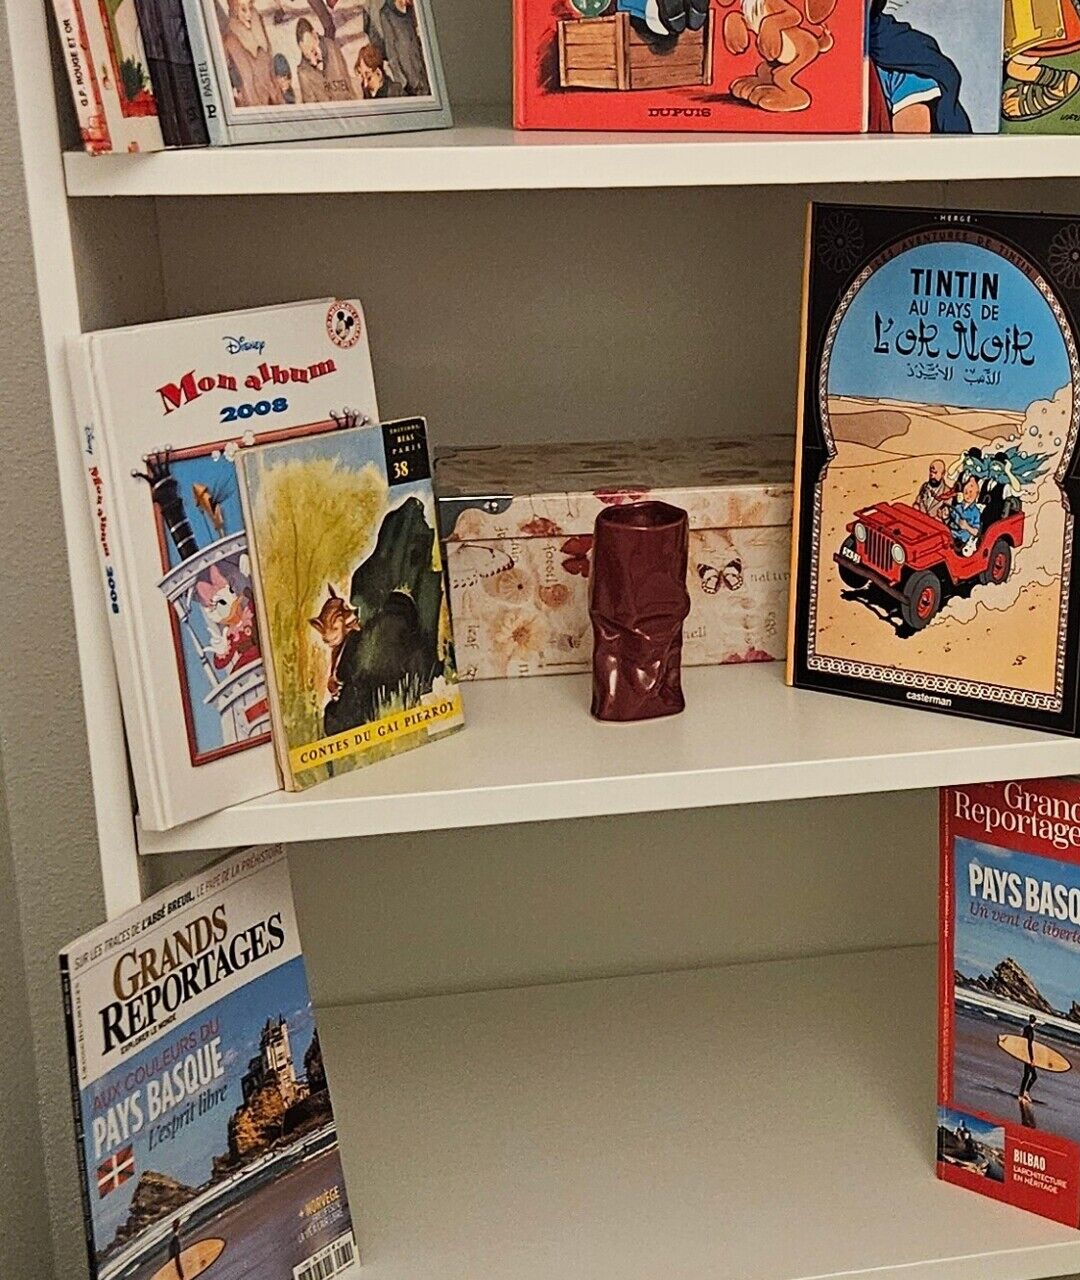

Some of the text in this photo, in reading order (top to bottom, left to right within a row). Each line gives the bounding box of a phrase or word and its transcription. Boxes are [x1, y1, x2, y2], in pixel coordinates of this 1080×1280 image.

[66, 36, 77, 50] ET
[72, 54, 85, 86] ROUGE
[198, 61, 213, 98] PASTEL
[647, 107, 711, 118] DUPUIS
[901, 231, 968, 250] AVENTURES
[976, 235, 994, 249] DE
[997, 244, 1034, 277] TINTIN
[910, 268, 999, 300] TINTIN
[909, 299, 1000, 321] AU PAYS DE
[222, 335, 266, 356] Disney
[156, 357, 337, 416] Mon album
[219, 397, 289, 424] 2008
[393, 460, 410, 480] 38
[89, 466, 104, 505] Mon
[97, 507, 111, 558] album
[106, 566, 120, 615] 2008
[906, 691, 952, 707] casterman
[300, 737, 350, 764] CONTES
[354, 729, 372, 746] DU
[377, 721, 399, 737] GAI
[968, 863, 1023, 909] PAYS
[969, 901, 990, 919] Un
[991, 908, 1021, 929] vent
[1023, 916, 1040, 933] de
[113, 904, 228, 1001] GRANDS
[98, 912, 285, 1056] REPORTAGES
[93, 1016, 220, 1111] AUX COULEURS DU
[92, 1089, 144, 1160] PAYS
[147, 1035, 225, 1122] BASQUE
[149, 1084, 228, 1151] L'esprit libre
[1013, 1148, 1046, 1172] BILBAO
